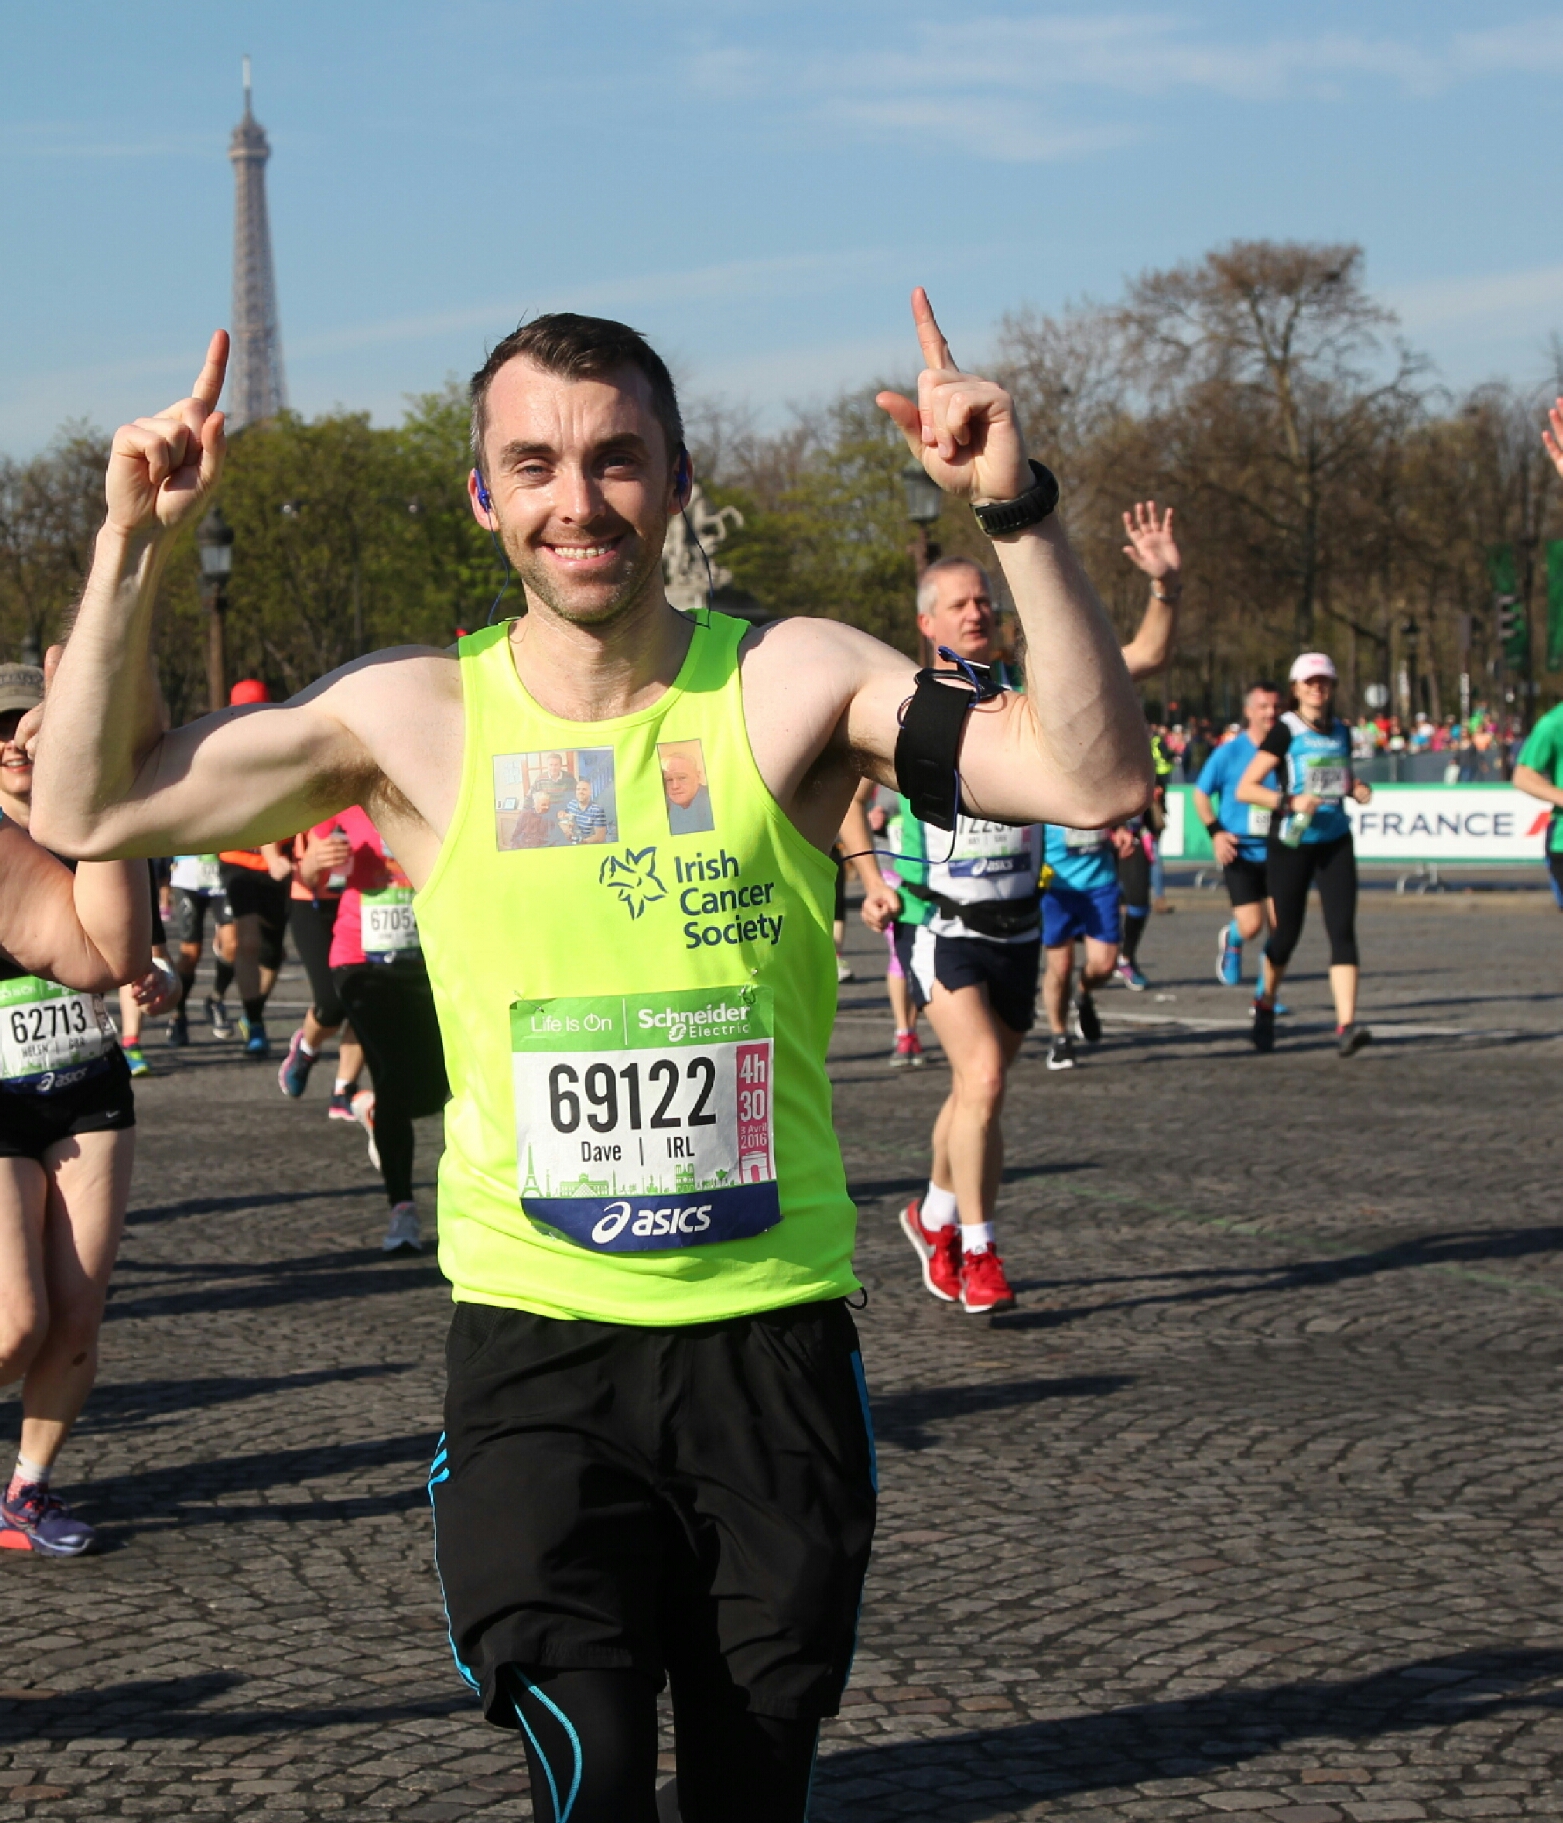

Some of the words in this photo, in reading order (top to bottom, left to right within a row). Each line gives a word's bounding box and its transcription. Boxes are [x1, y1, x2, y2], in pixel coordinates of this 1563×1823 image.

[1350, 812, 1515, 836] FRANCE
[674, 849, 739, 883] Irish
[679, 881, 774, 916] Cancer
[370, 907, 416, 931] 6705
[683, 914, 784, 949] Society
[11, 1001, 87, 1044] 62713
[530, 1015, 562, 1032] Life
[566, 1015, 580, 1032] Is
[583, 1013, 613, 1032] On
[638, 1003, 750, 1029] Schneider
[688, 1023, 750, 1038] Electric
[740, 1053, 766, 1084] 4h
[548, 1056, 717, 1134] 69122
[740, 1089, 766, 1122] 30
[748, 1122, 768, 1134] Avril
[580, 1141, 622, 1162] Dave
[667, 1136, 695, 1158] IRL
[740, 1133, 768, 1150] 2016
